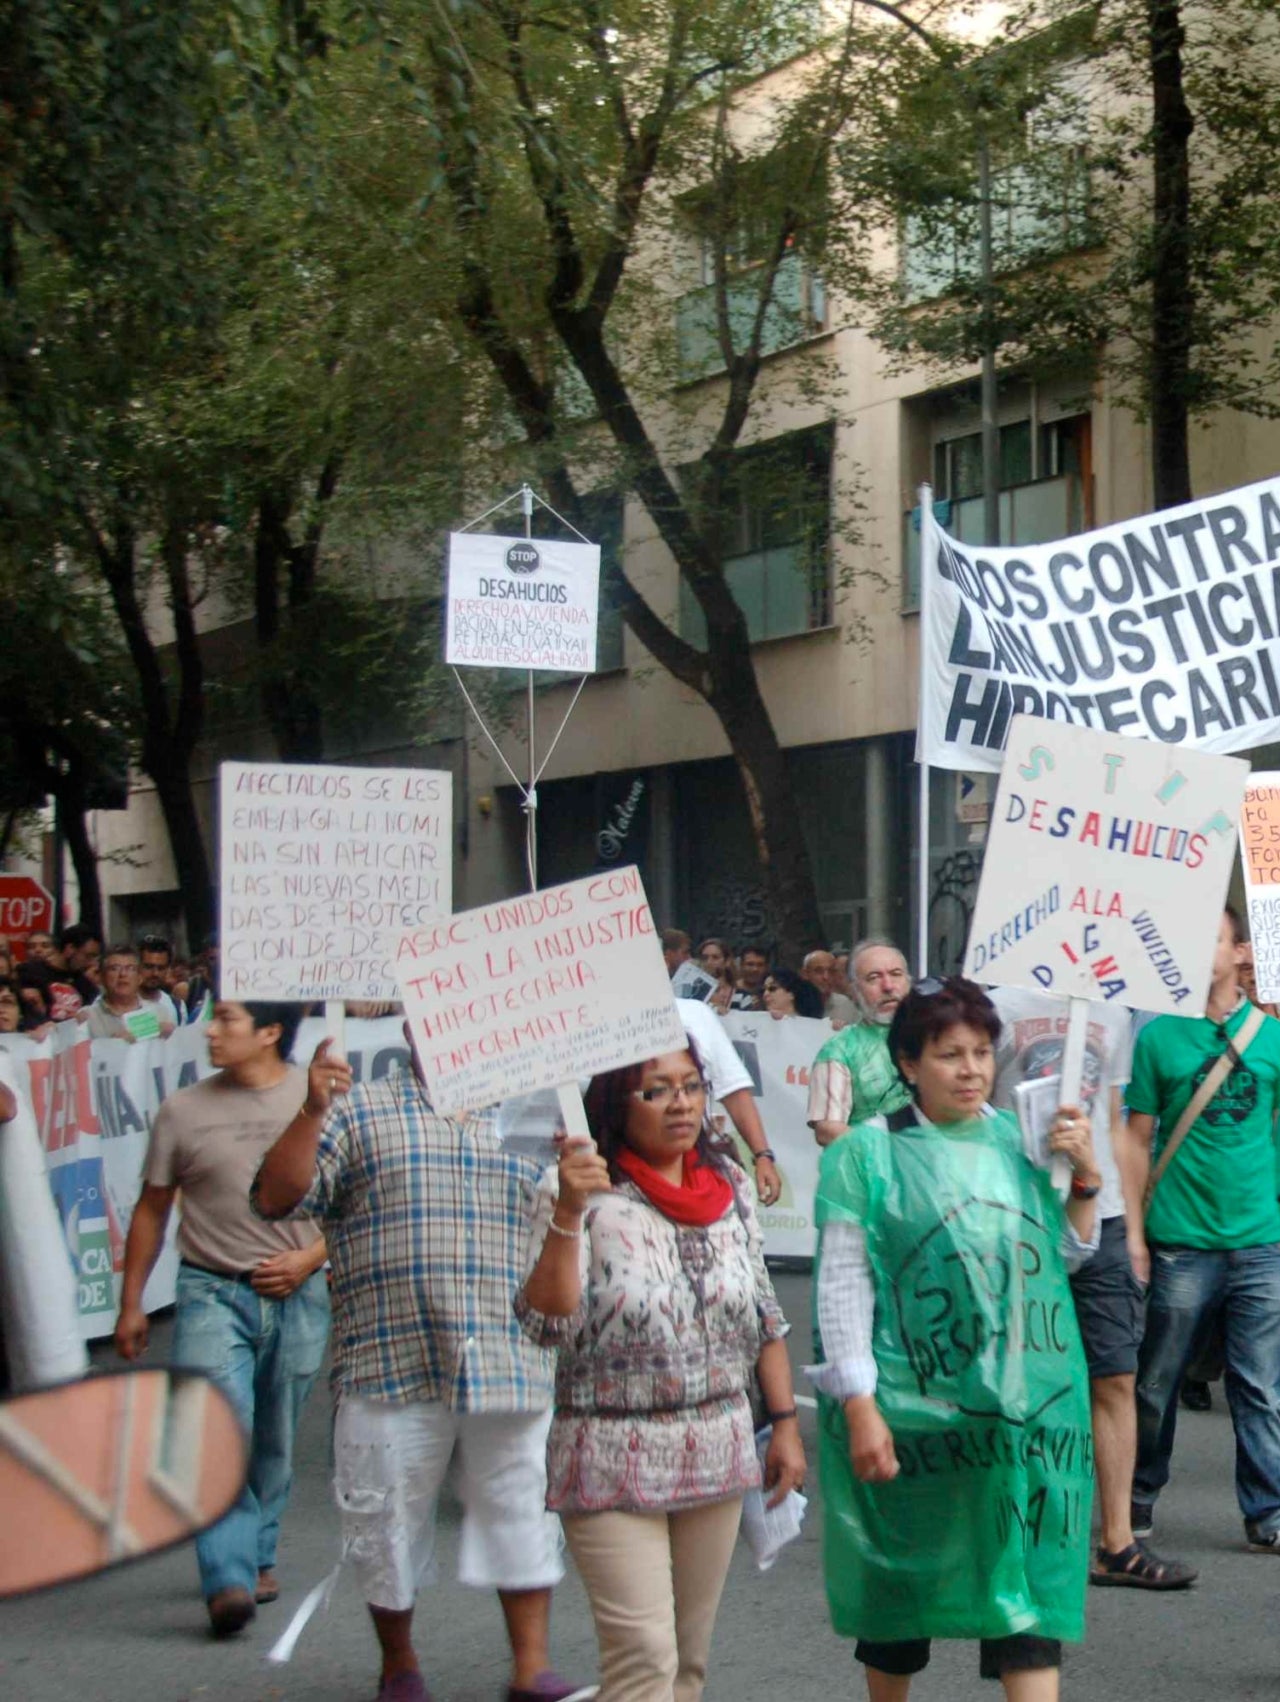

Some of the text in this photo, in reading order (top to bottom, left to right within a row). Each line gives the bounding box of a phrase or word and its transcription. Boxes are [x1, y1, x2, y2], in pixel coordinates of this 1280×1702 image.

[509, 551, 538, 563] STOP
[478, 577, 568, 604] DESAHUCIOS
[236, 772, 441, 801] AFECTADOS SE LES
[1005, 793, 1209, 869] DESAHUCIOS
[276, 841, 321, 867] SIN
[334, 842, 439, 872] APLICAR
[0, 897, 45, 928] TOP
[484, 889, 574, 934] UNIDOS
[588, 870, 639, 902] CON
[972, 884, 1061, 974] DERECHO
[1130, 910, 1192, 1004] VIVIENDA
[485, 945, 525, 979] LA
[423, 958, 596, 1039] HIPOTECARIA
[913, 1240, 1042, 1325] STOP
